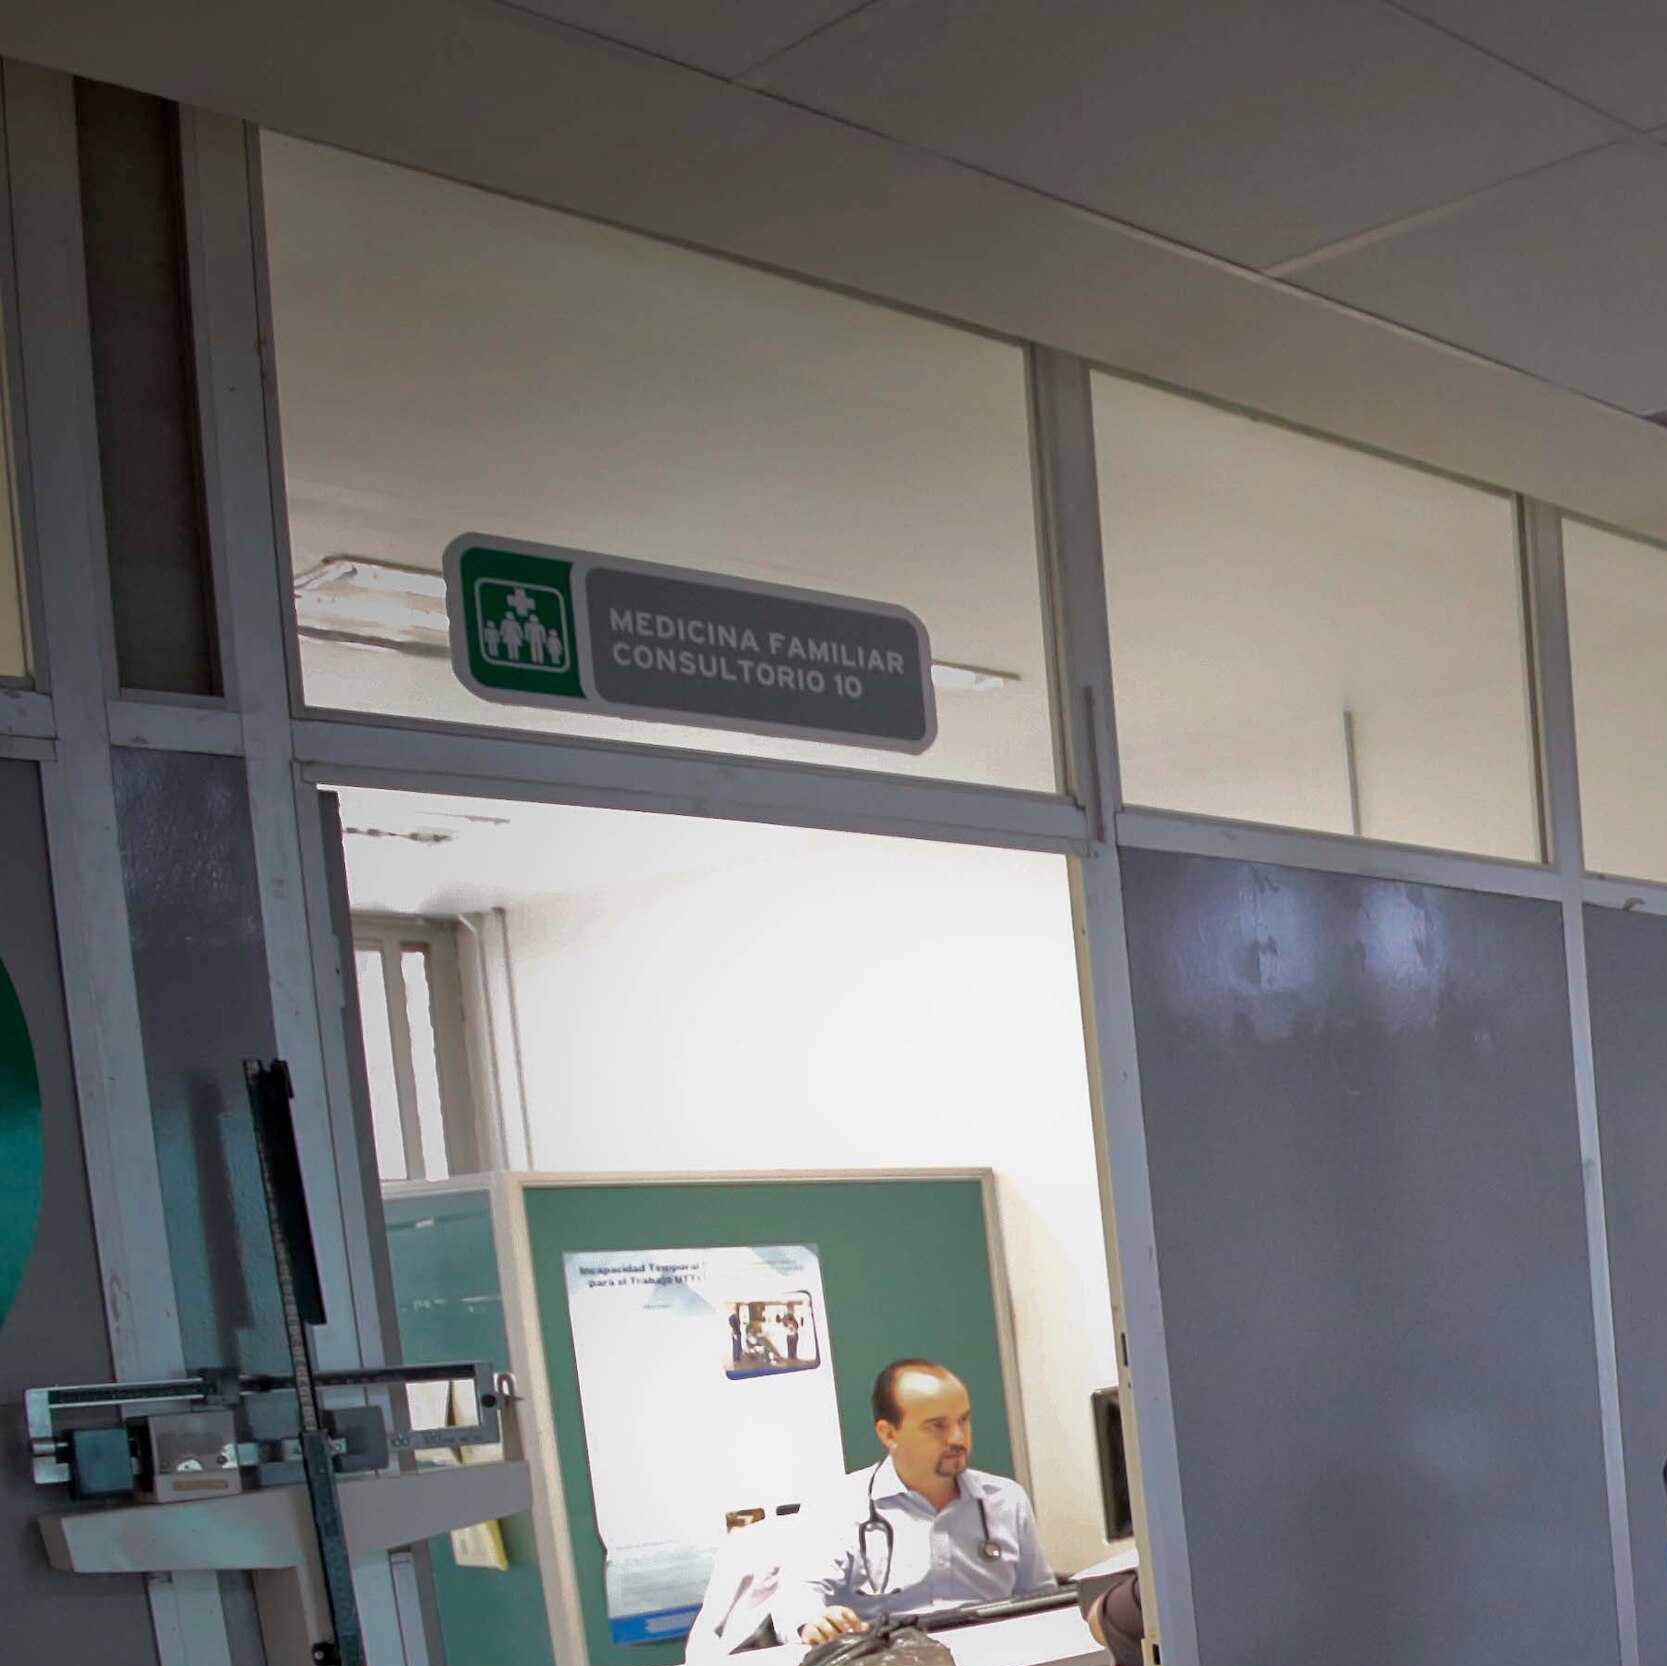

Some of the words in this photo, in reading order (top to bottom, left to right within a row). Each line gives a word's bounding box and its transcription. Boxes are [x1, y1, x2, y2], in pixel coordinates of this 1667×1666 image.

[609, 607, 759, 655] MEDICINA
[768, 632, 906, 676] FAMILIAR
[611, 642, 825, 695] CONSULTORIO
[833, 673, 864, 699] 10
[579, 1263, 645, 1277] Incapacidad
[650, 1262, 700, 1276] Temporal
[588, 1278, 615, 1288] para
